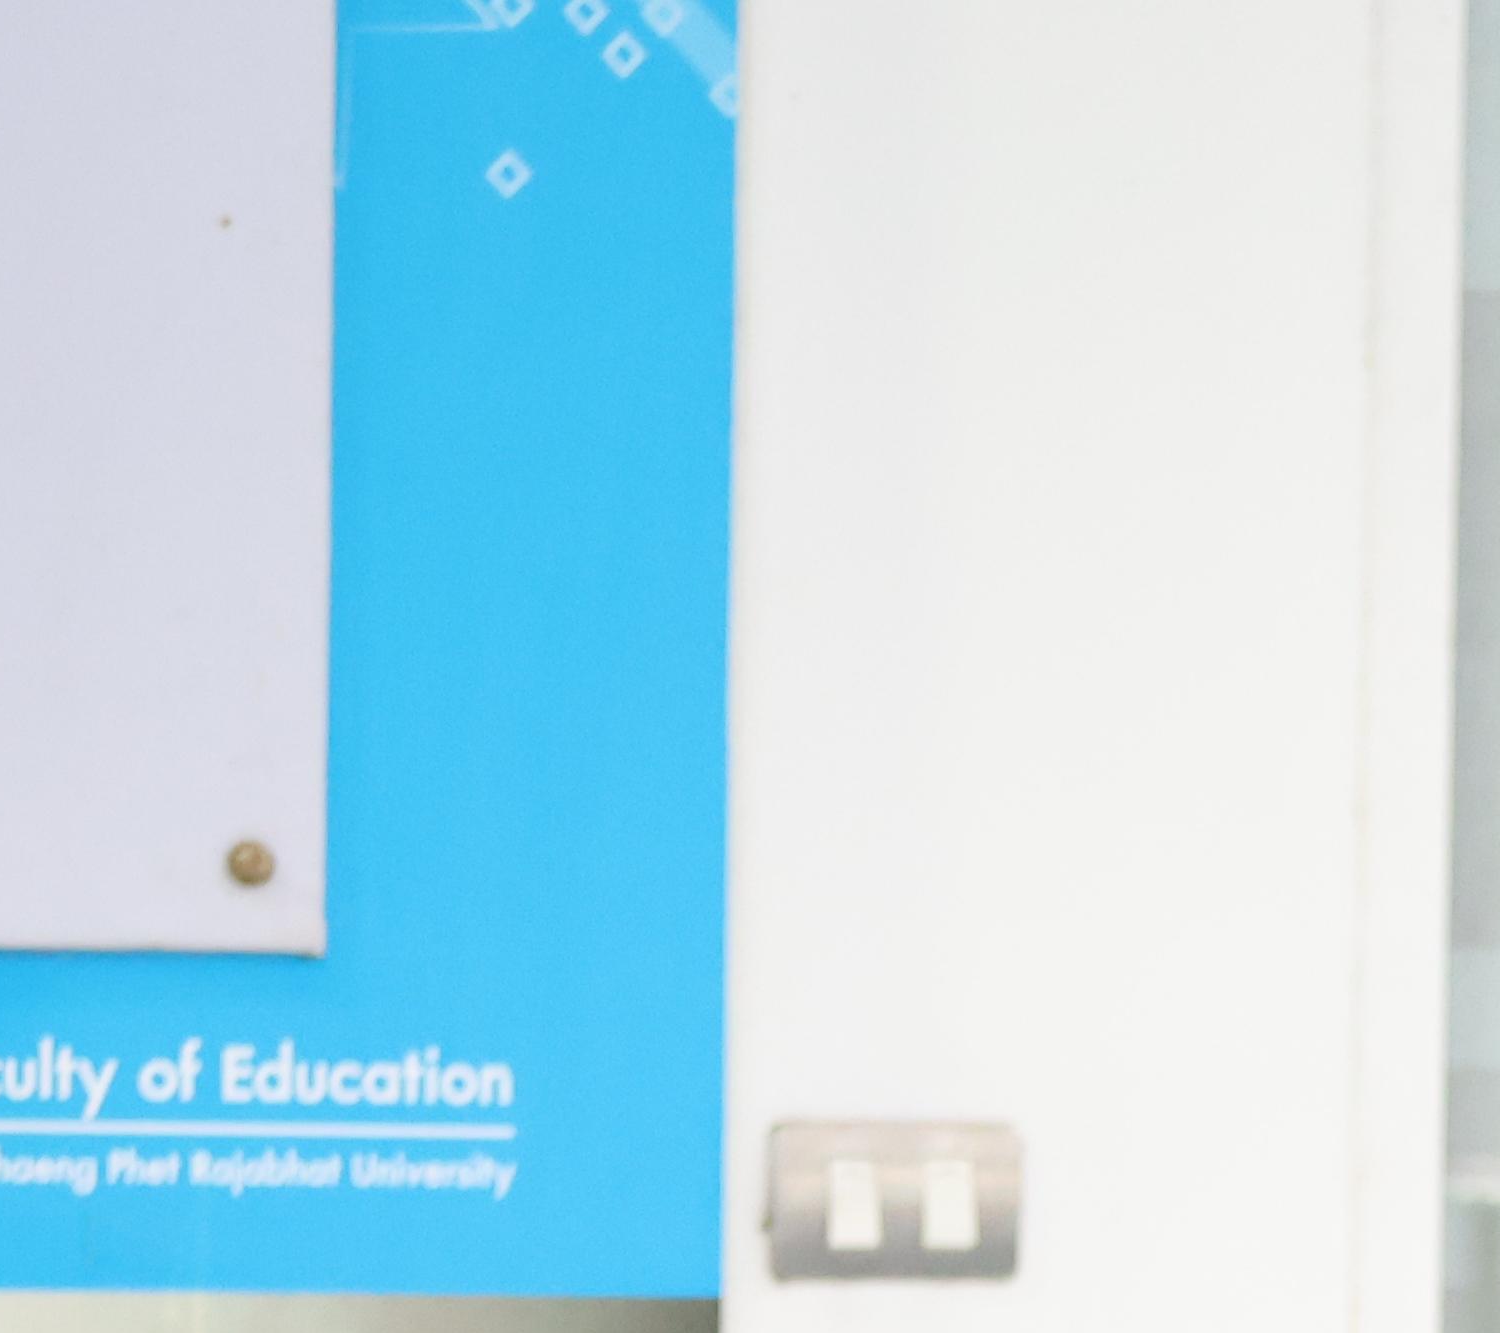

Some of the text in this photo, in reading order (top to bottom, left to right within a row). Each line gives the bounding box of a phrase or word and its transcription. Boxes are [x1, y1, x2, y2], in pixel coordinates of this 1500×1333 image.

[136, 1038, 203, 1102] of
[220, 1038, 515, 1108] Education
[107, 1147, 181, 1185] Phet
[190, 1148, 343, 1197] Rajabhat
[351, 1149, 518, 1200] University
